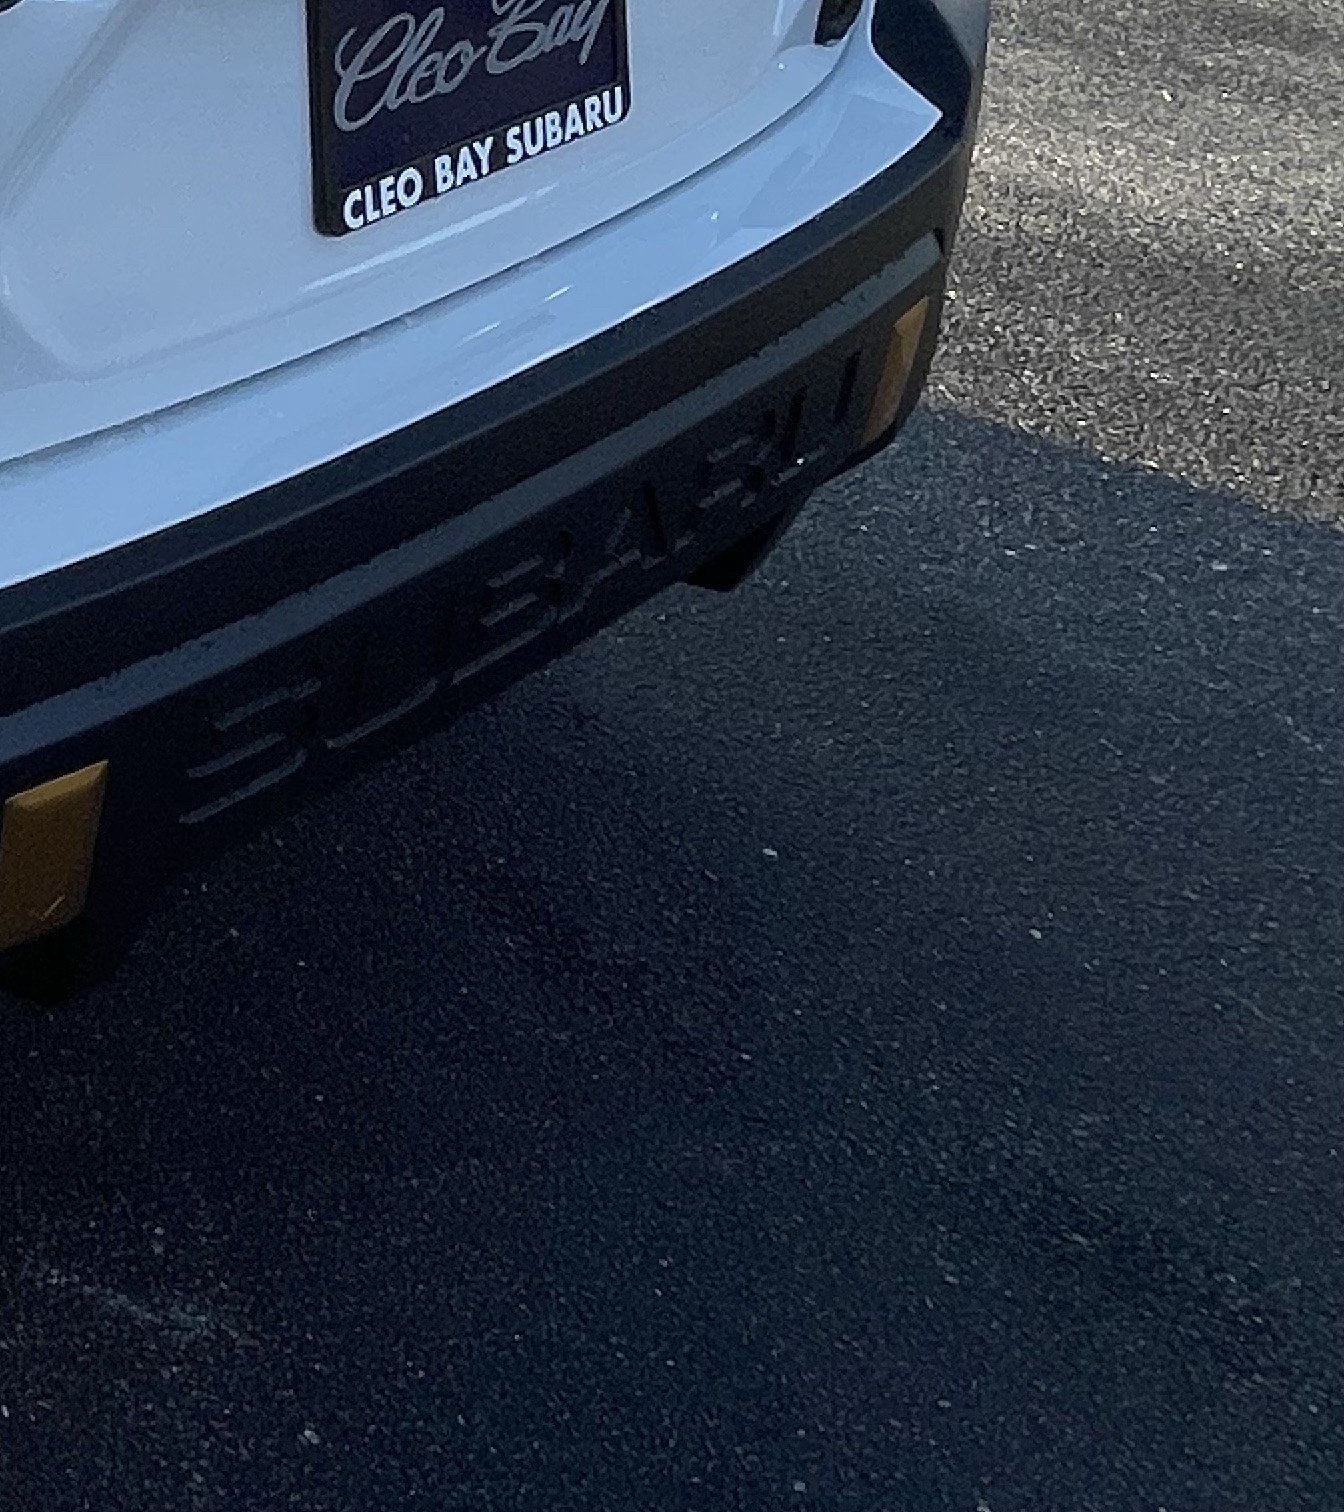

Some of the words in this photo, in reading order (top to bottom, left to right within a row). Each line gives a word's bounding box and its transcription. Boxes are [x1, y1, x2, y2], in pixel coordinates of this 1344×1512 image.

[333, 5, 486, 133] Cleo
[342, 166, 424, 230] CLEO
[433, 136, 495, 194] BAY
[505, 85, 624, 166] SUBARU
